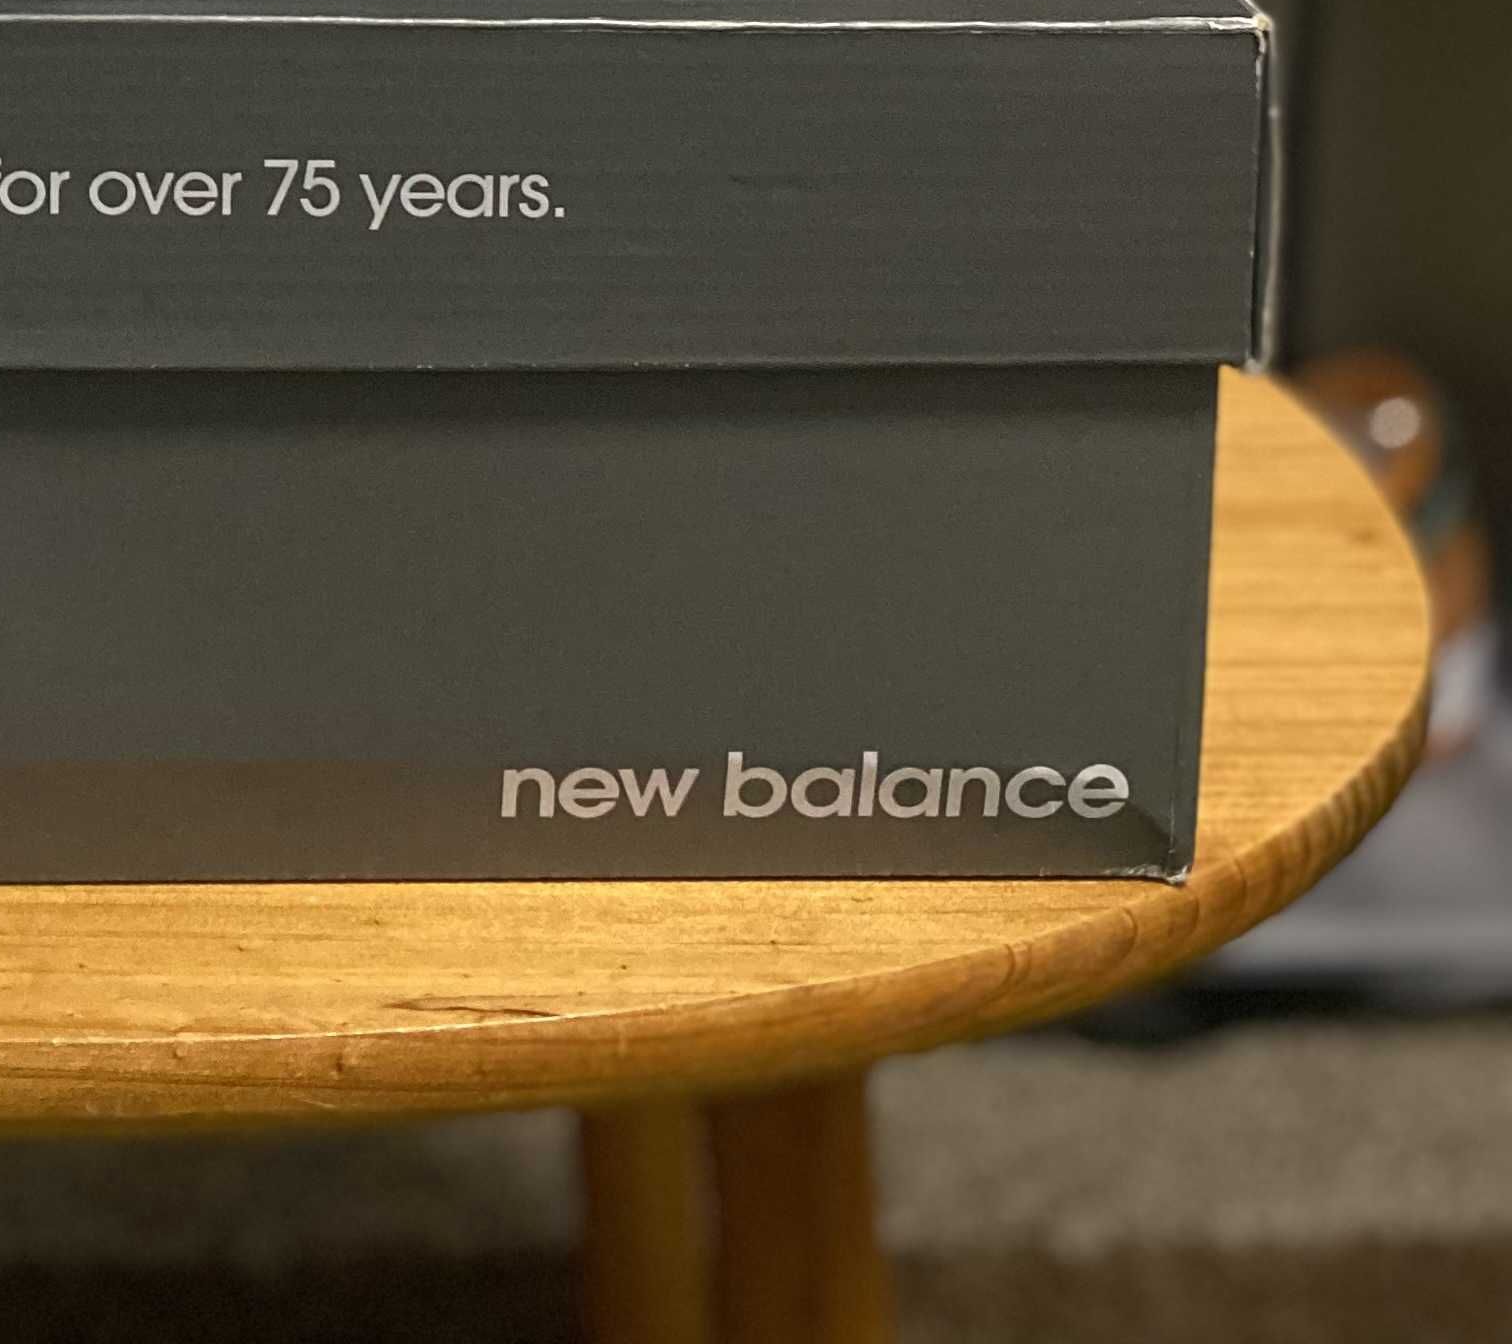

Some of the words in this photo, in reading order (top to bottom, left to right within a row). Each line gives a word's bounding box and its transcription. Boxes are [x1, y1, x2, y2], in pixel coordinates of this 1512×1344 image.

[88, 170, 243, 216] over
[263, 159, 341, 217] 75
[359, 173, 565, 231] years.
[501, 767, 700, 819] new
[723, 750, 1130, 819] balance
